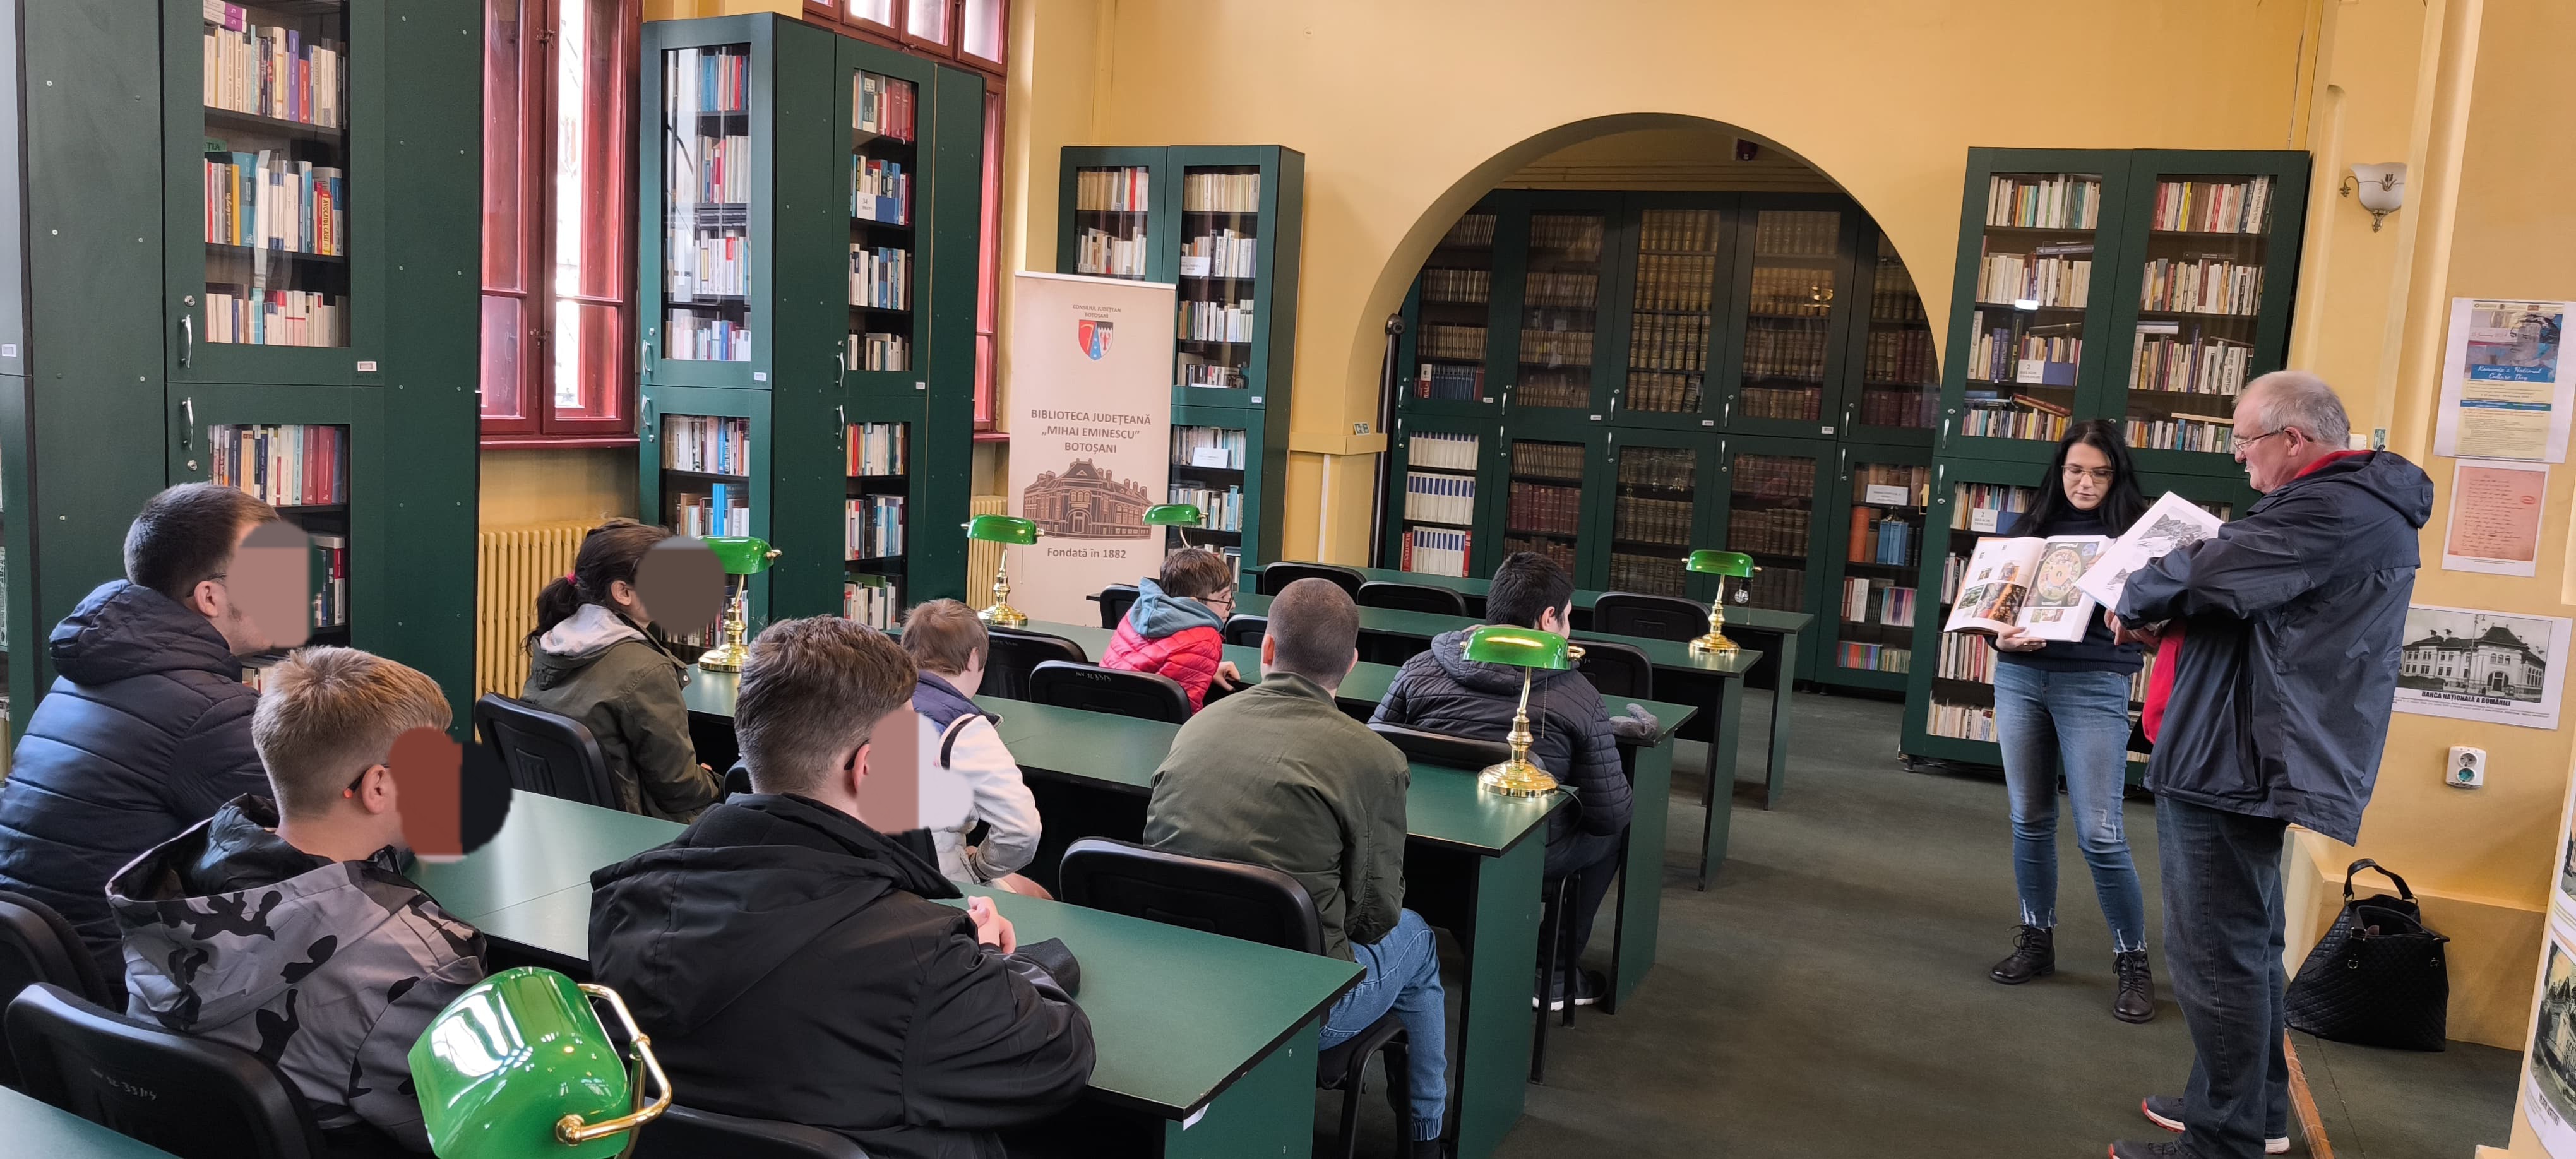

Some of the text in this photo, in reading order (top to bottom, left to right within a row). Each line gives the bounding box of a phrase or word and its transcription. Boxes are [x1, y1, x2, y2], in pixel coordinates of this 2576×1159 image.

[2478, 365, 2510, 373] Romania's
[1031, 409, 1151, 425] BIBLIOTECA JUDEȚEANĂ
[1064, 442, 1117, 455] BOTOȘANI
[1047, 547, 1126, 559] Fondată în 1882
[2421, 691, 2442, 699] BANCA
